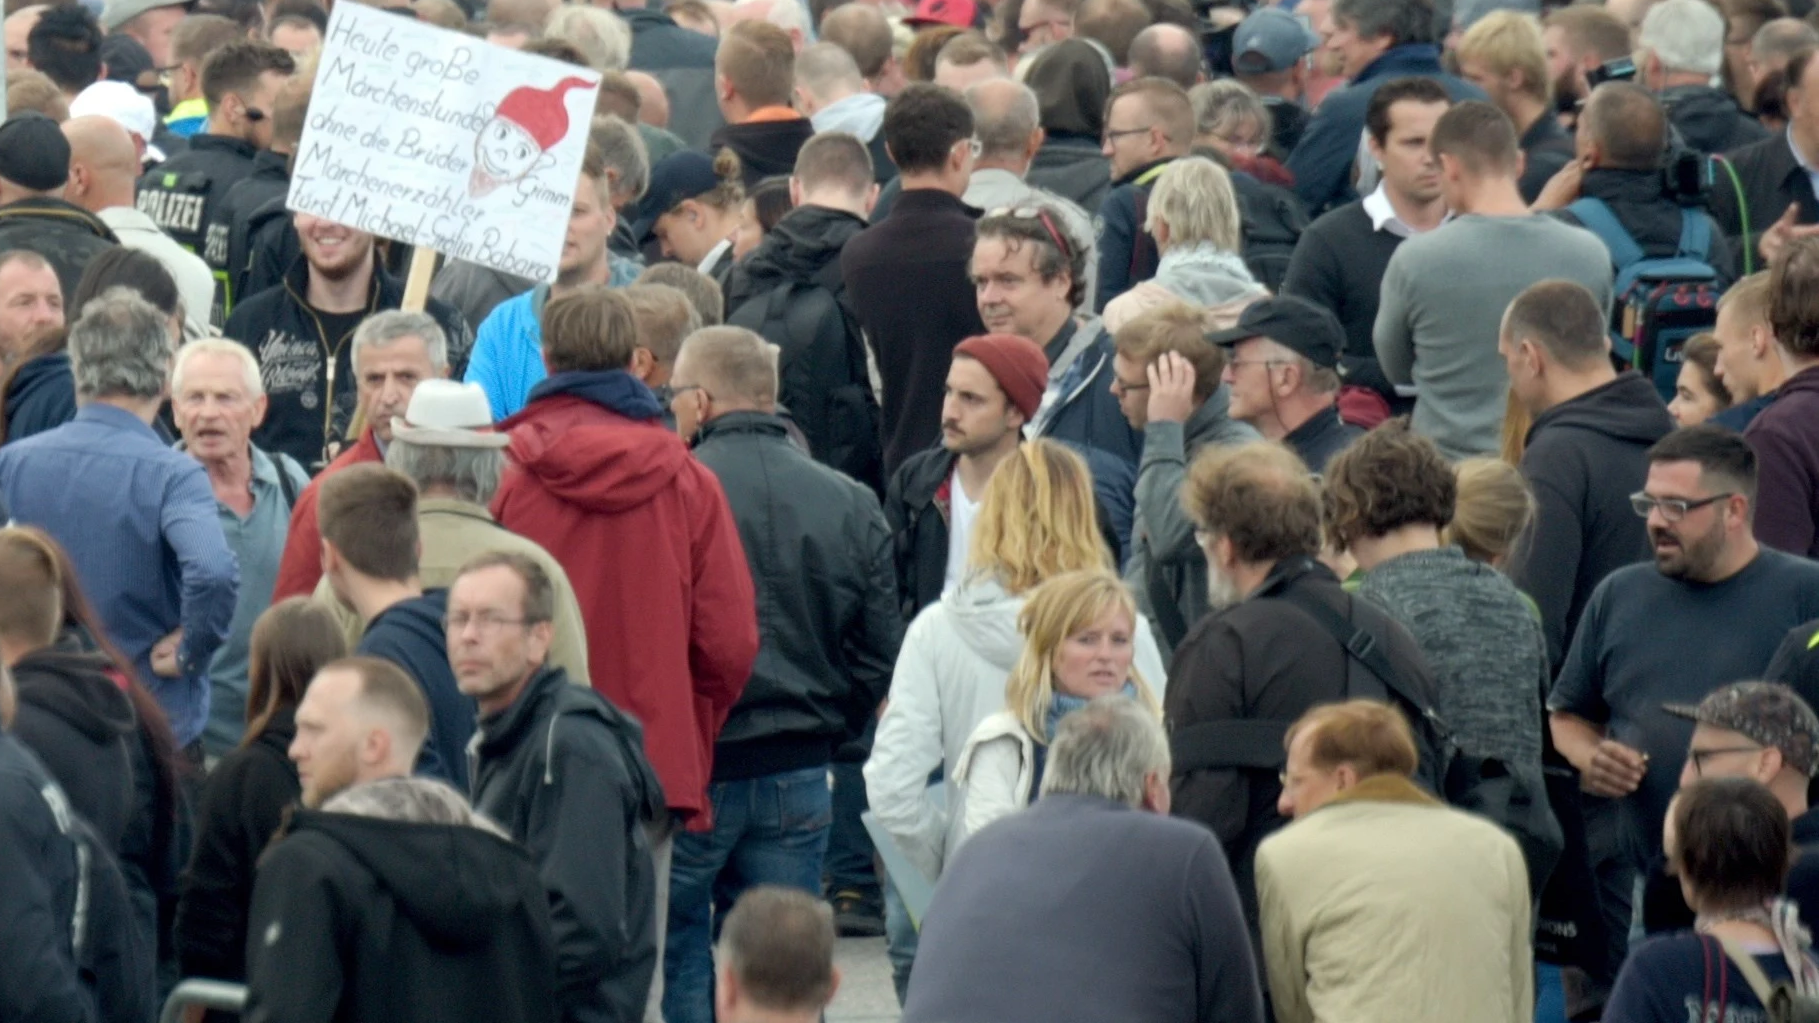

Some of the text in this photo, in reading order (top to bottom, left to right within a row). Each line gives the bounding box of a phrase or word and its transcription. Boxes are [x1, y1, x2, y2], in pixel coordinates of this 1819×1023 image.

[330, 13, 400, 62] Heute
[300, 141, 485, 222] Märchenerzähler
[310, 106, 570, 208] ohne die Brüder Grimm
[137, 189, 204, 232] POLIZEI
[476, 226, 552, 280] Babara
